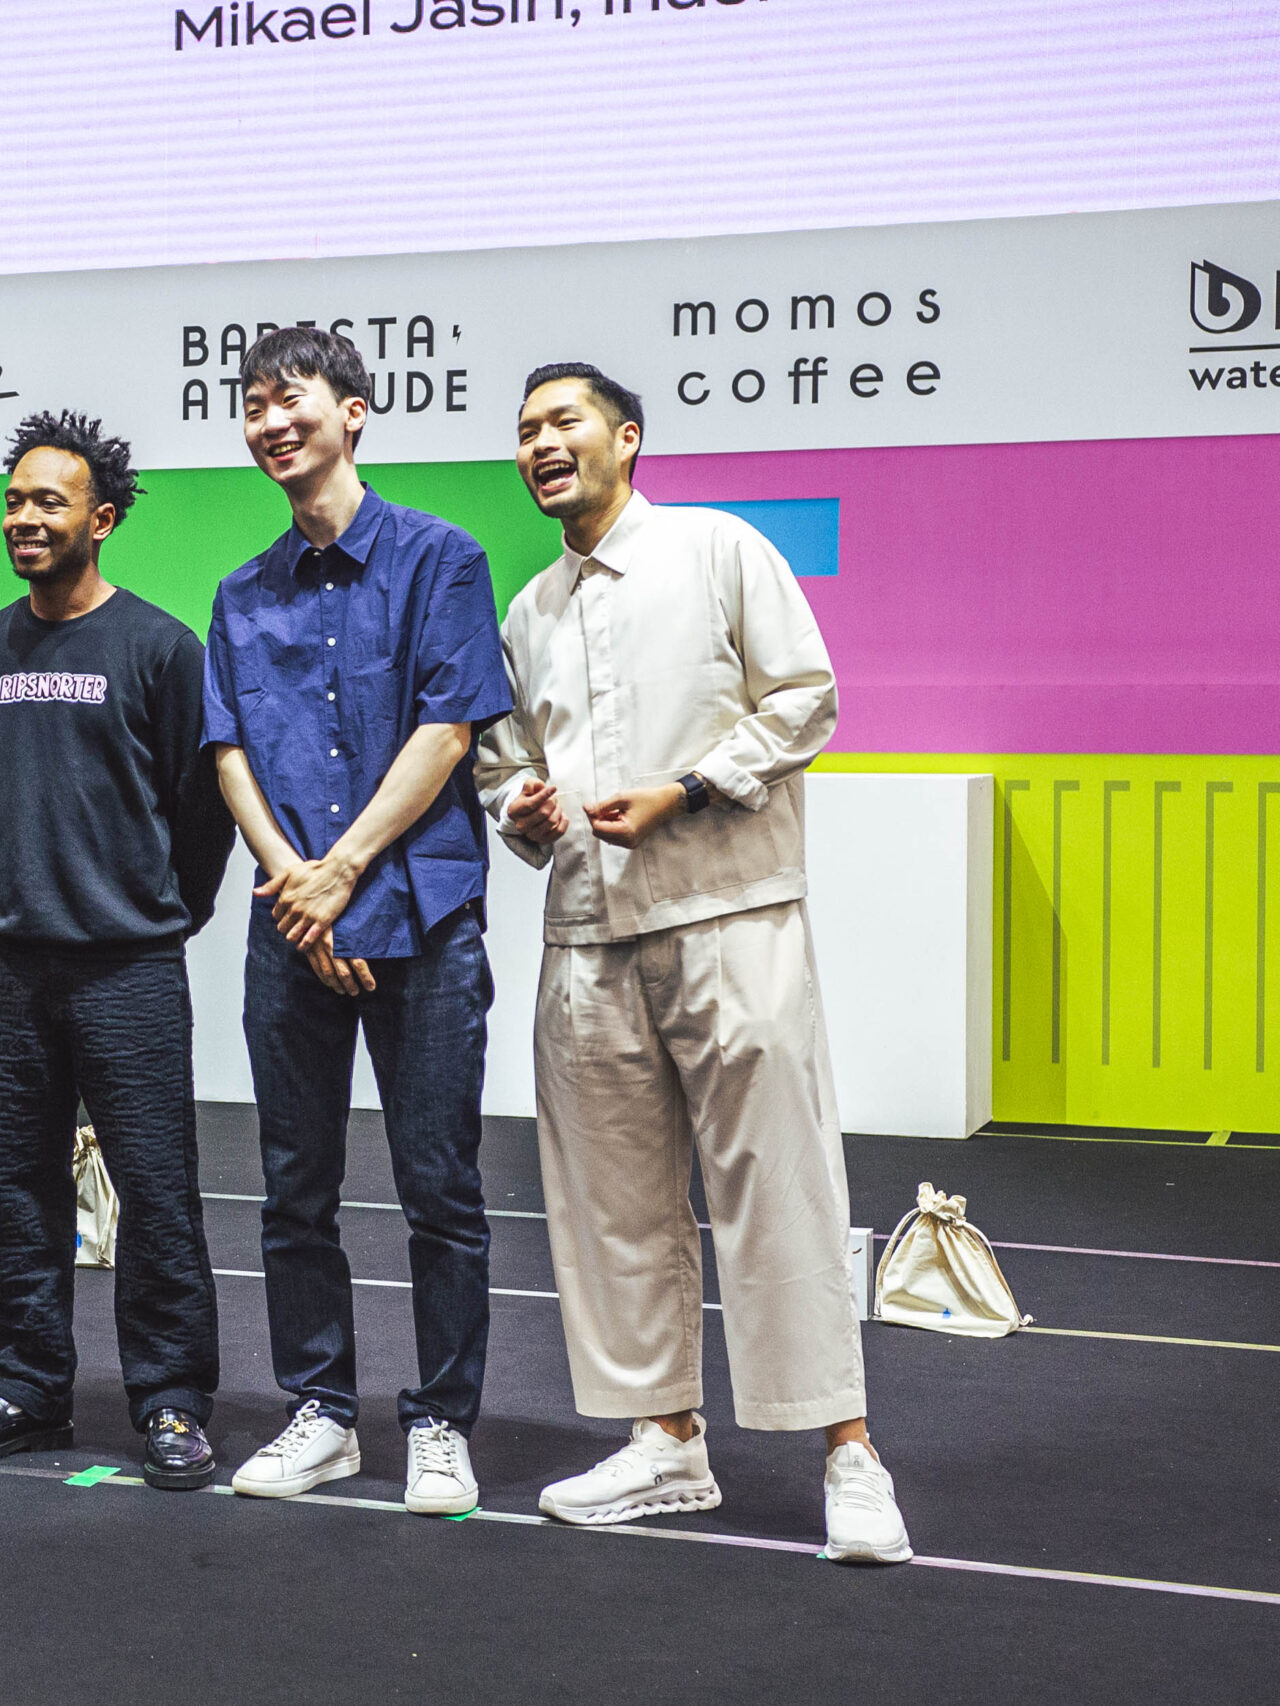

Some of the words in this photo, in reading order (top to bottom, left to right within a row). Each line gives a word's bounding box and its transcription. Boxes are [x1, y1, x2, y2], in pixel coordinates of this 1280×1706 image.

[175, 0, 370, 51] Mikael
[673, 288, 941, 337] momos
[182, 314, 435, 367] BASTA
[182, 369, 467, 421] ATUDE
[677, 356, 941, 405] coffee
